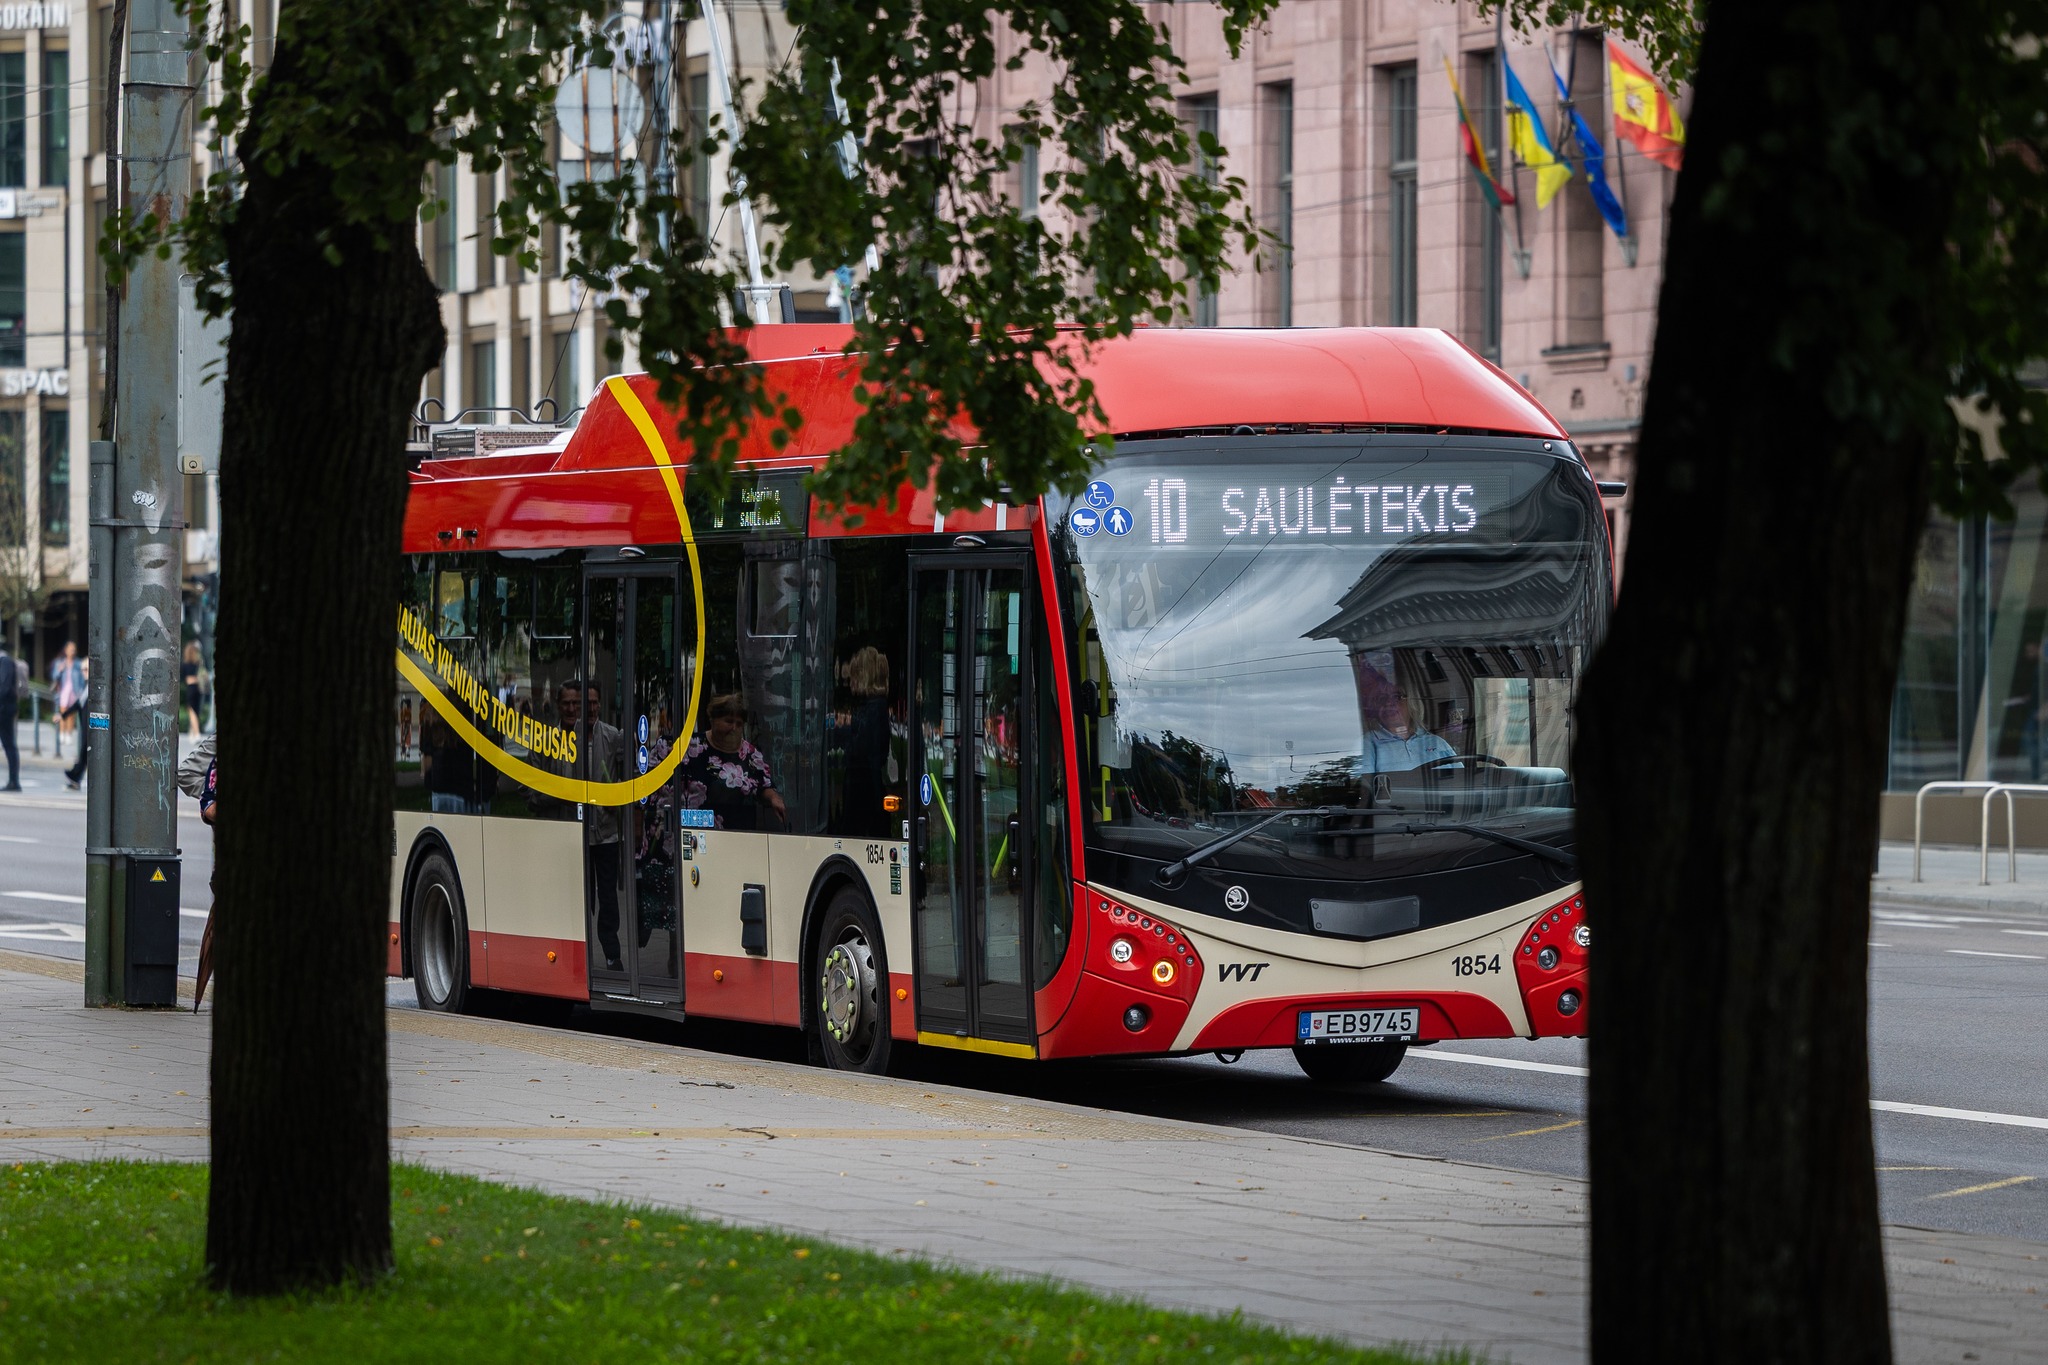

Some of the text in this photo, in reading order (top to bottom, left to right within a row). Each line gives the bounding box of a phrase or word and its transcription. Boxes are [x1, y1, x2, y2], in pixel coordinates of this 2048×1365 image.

[1143, 476, 1477, 543] 10 SAULĖTEKIS
[437, 642, 490, 721] VILNIAUS
[491, 695, 577, 764] TROLEIBUSAS
[866, 844, 884, 864] 1854
[1218, 962, 1270, 982] VVT
[1451, 954, 1501, 977] 1854
[1326, 1012, 1412, 1034] EB9745
[1329, 1036, 1385, 1044] www.sor.cz
